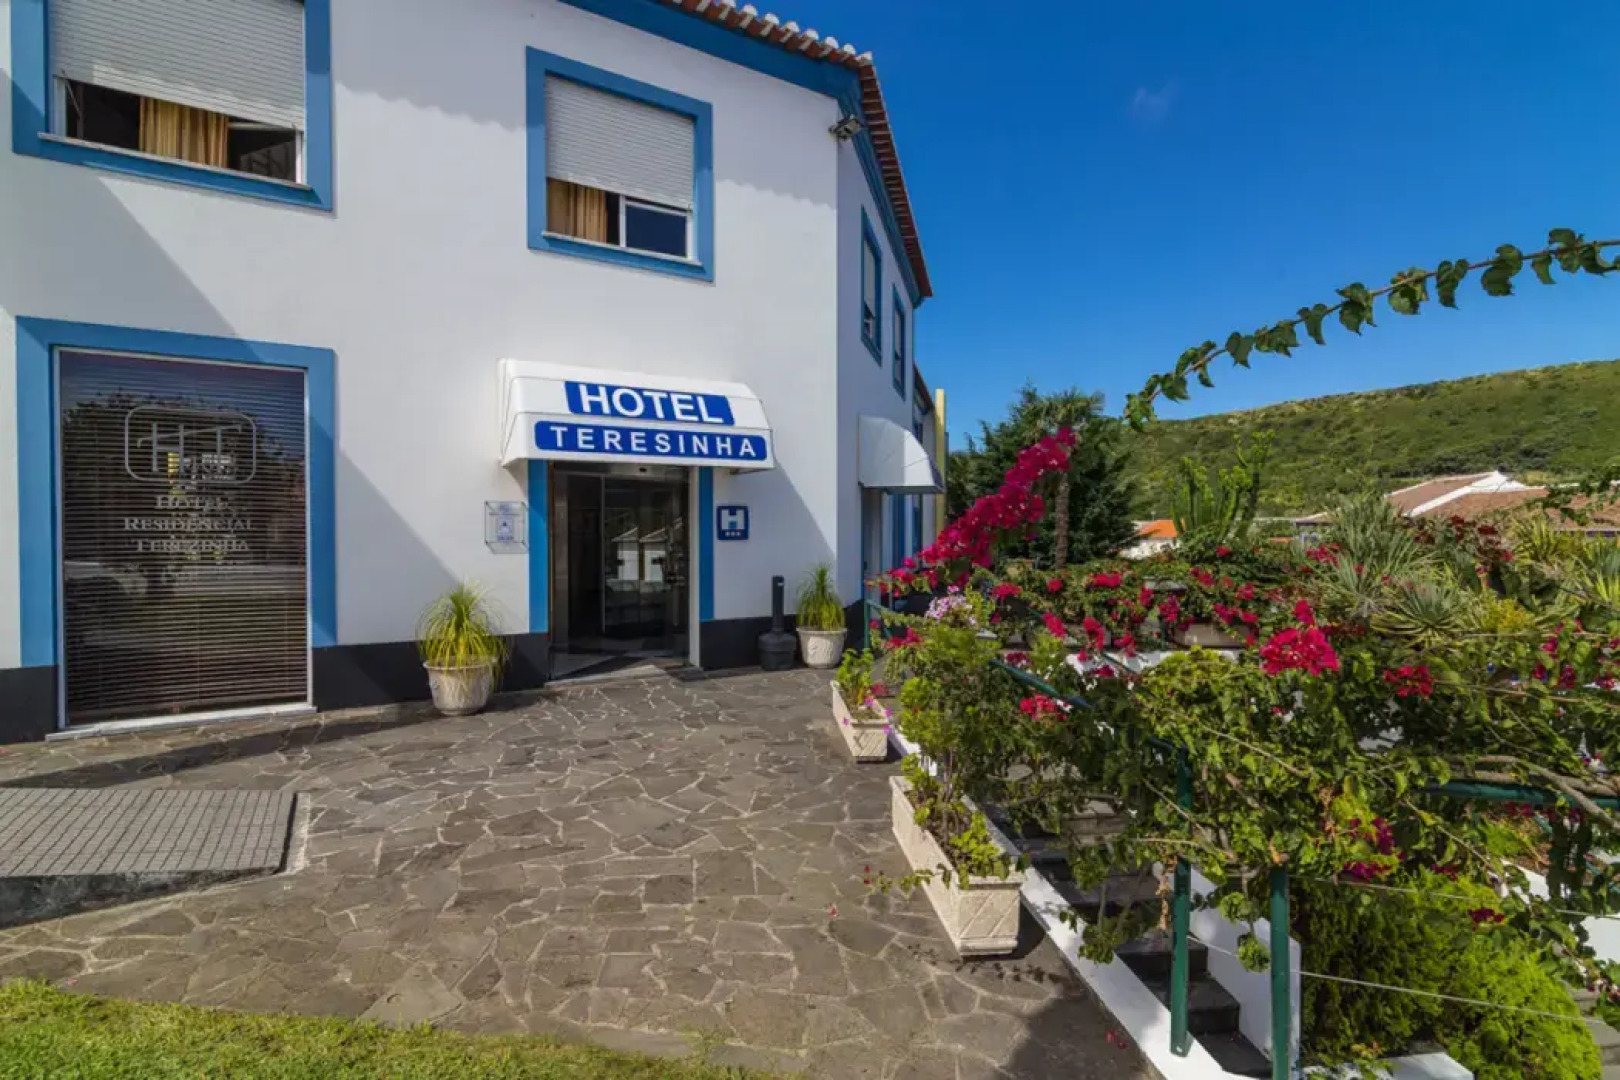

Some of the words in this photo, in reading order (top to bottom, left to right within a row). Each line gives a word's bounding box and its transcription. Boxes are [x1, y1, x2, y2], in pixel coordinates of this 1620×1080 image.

[579, 383, 724, 424] HOTEL
[549, 426, 756, 457] TERESINHA
[124, 517, 254, 531] RESIDENCIAL
[721, 509, 745, 530] H
